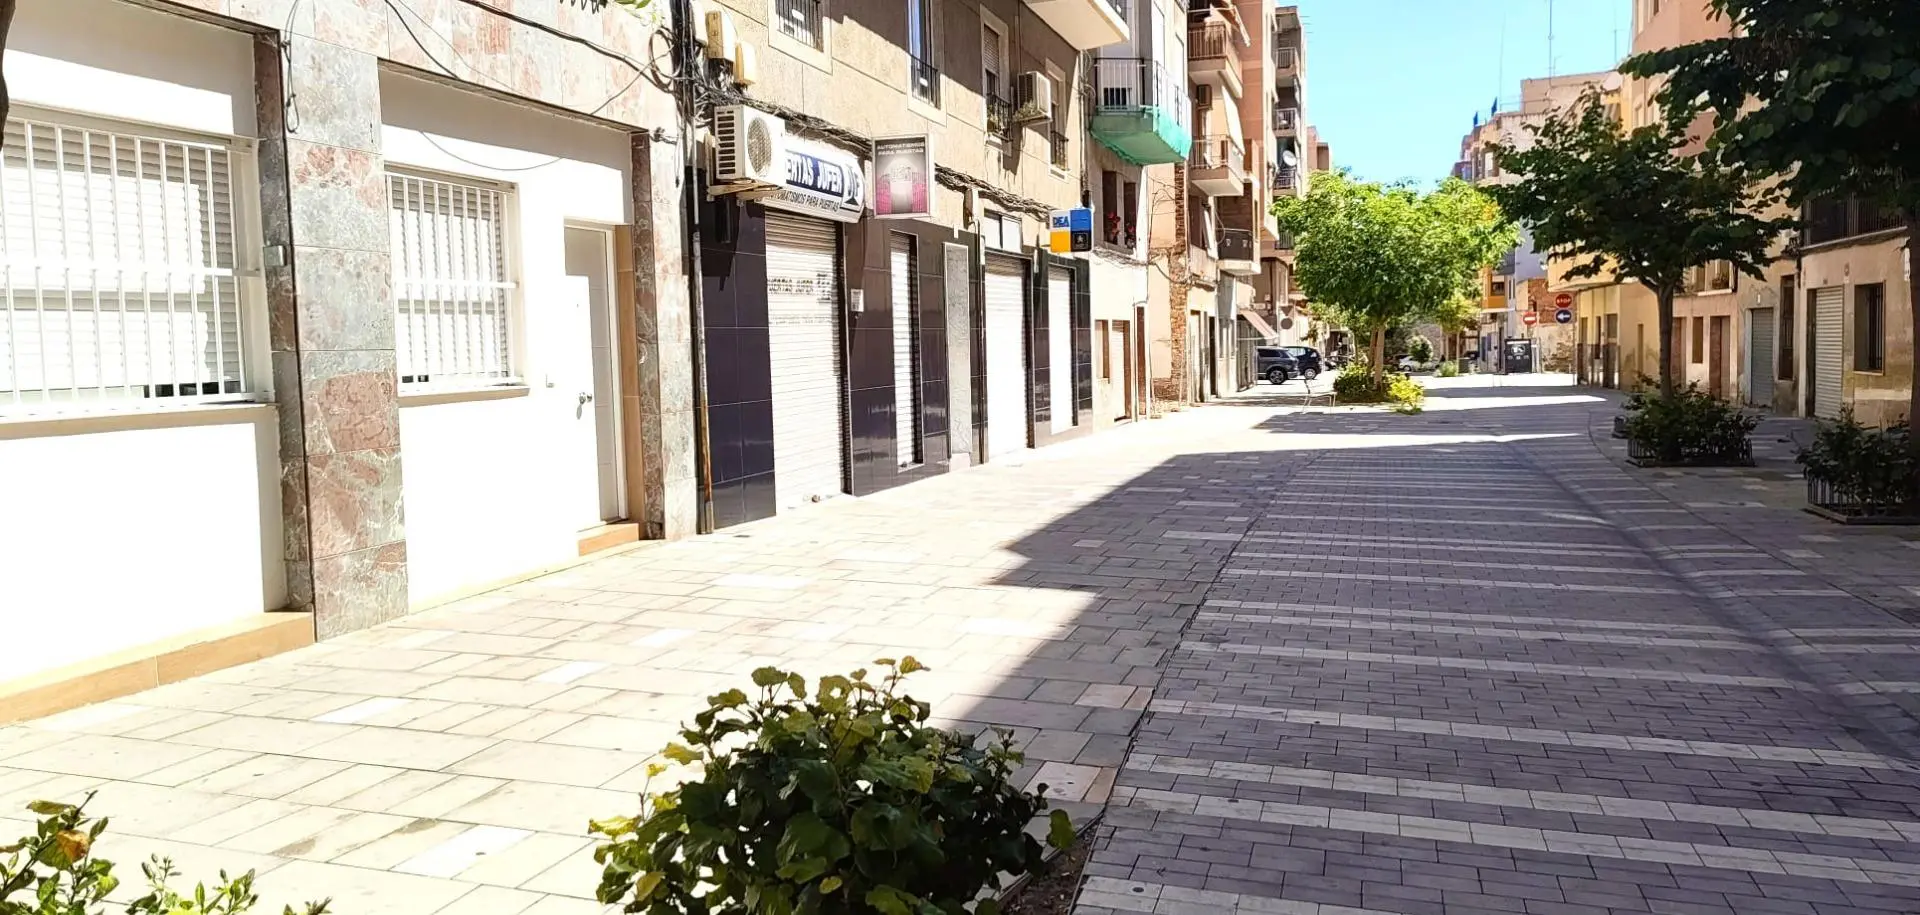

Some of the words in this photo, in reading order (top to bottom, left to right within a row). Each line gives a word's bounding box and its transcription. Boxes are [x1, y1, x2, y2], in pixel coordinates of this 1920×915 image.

[785, 155, 814, 187] ERTAS
[817, 160, 843, 194] JUFER
[819, 197, 839, 212] PUERTAS
[1052, 216, 1069, 228] DEA
